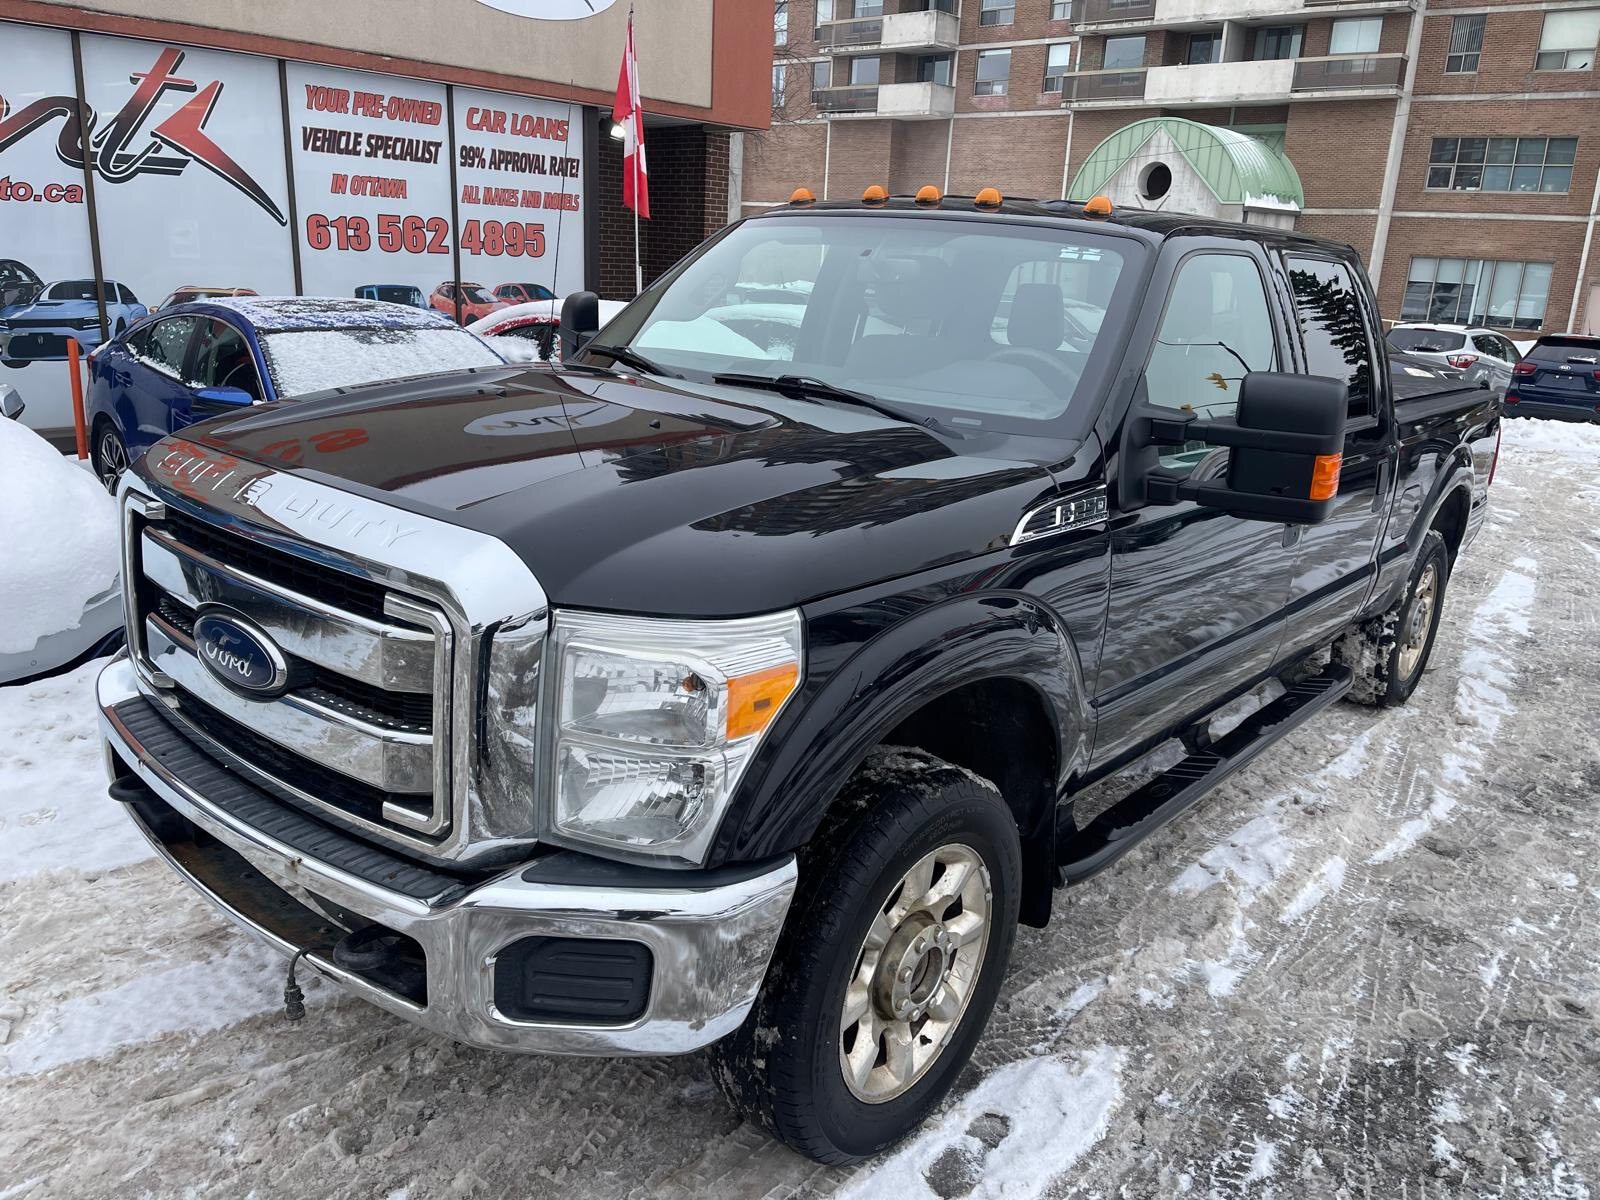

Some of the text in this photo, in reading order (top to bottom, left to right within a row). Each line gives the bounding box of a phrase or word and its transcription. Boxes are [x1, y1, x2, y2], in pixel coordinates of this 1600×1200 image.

[305, 84, 442, 125] YOUR PRE-OWNED
[466, 107, 569, 141] CAR LOANS
[301, 126, 442, 164] VEHICLE SPECIALIST
[460, 145, 580, 178] 99% APPROVAL RATE!
[331, 173, 407, 199] IN OTTAWA
[461, 185, 580, 212] ALL MAKES AND MODELS
[306, 214, 546, 257] 613 562 4895
[205, 627, 254, 678] Ford
